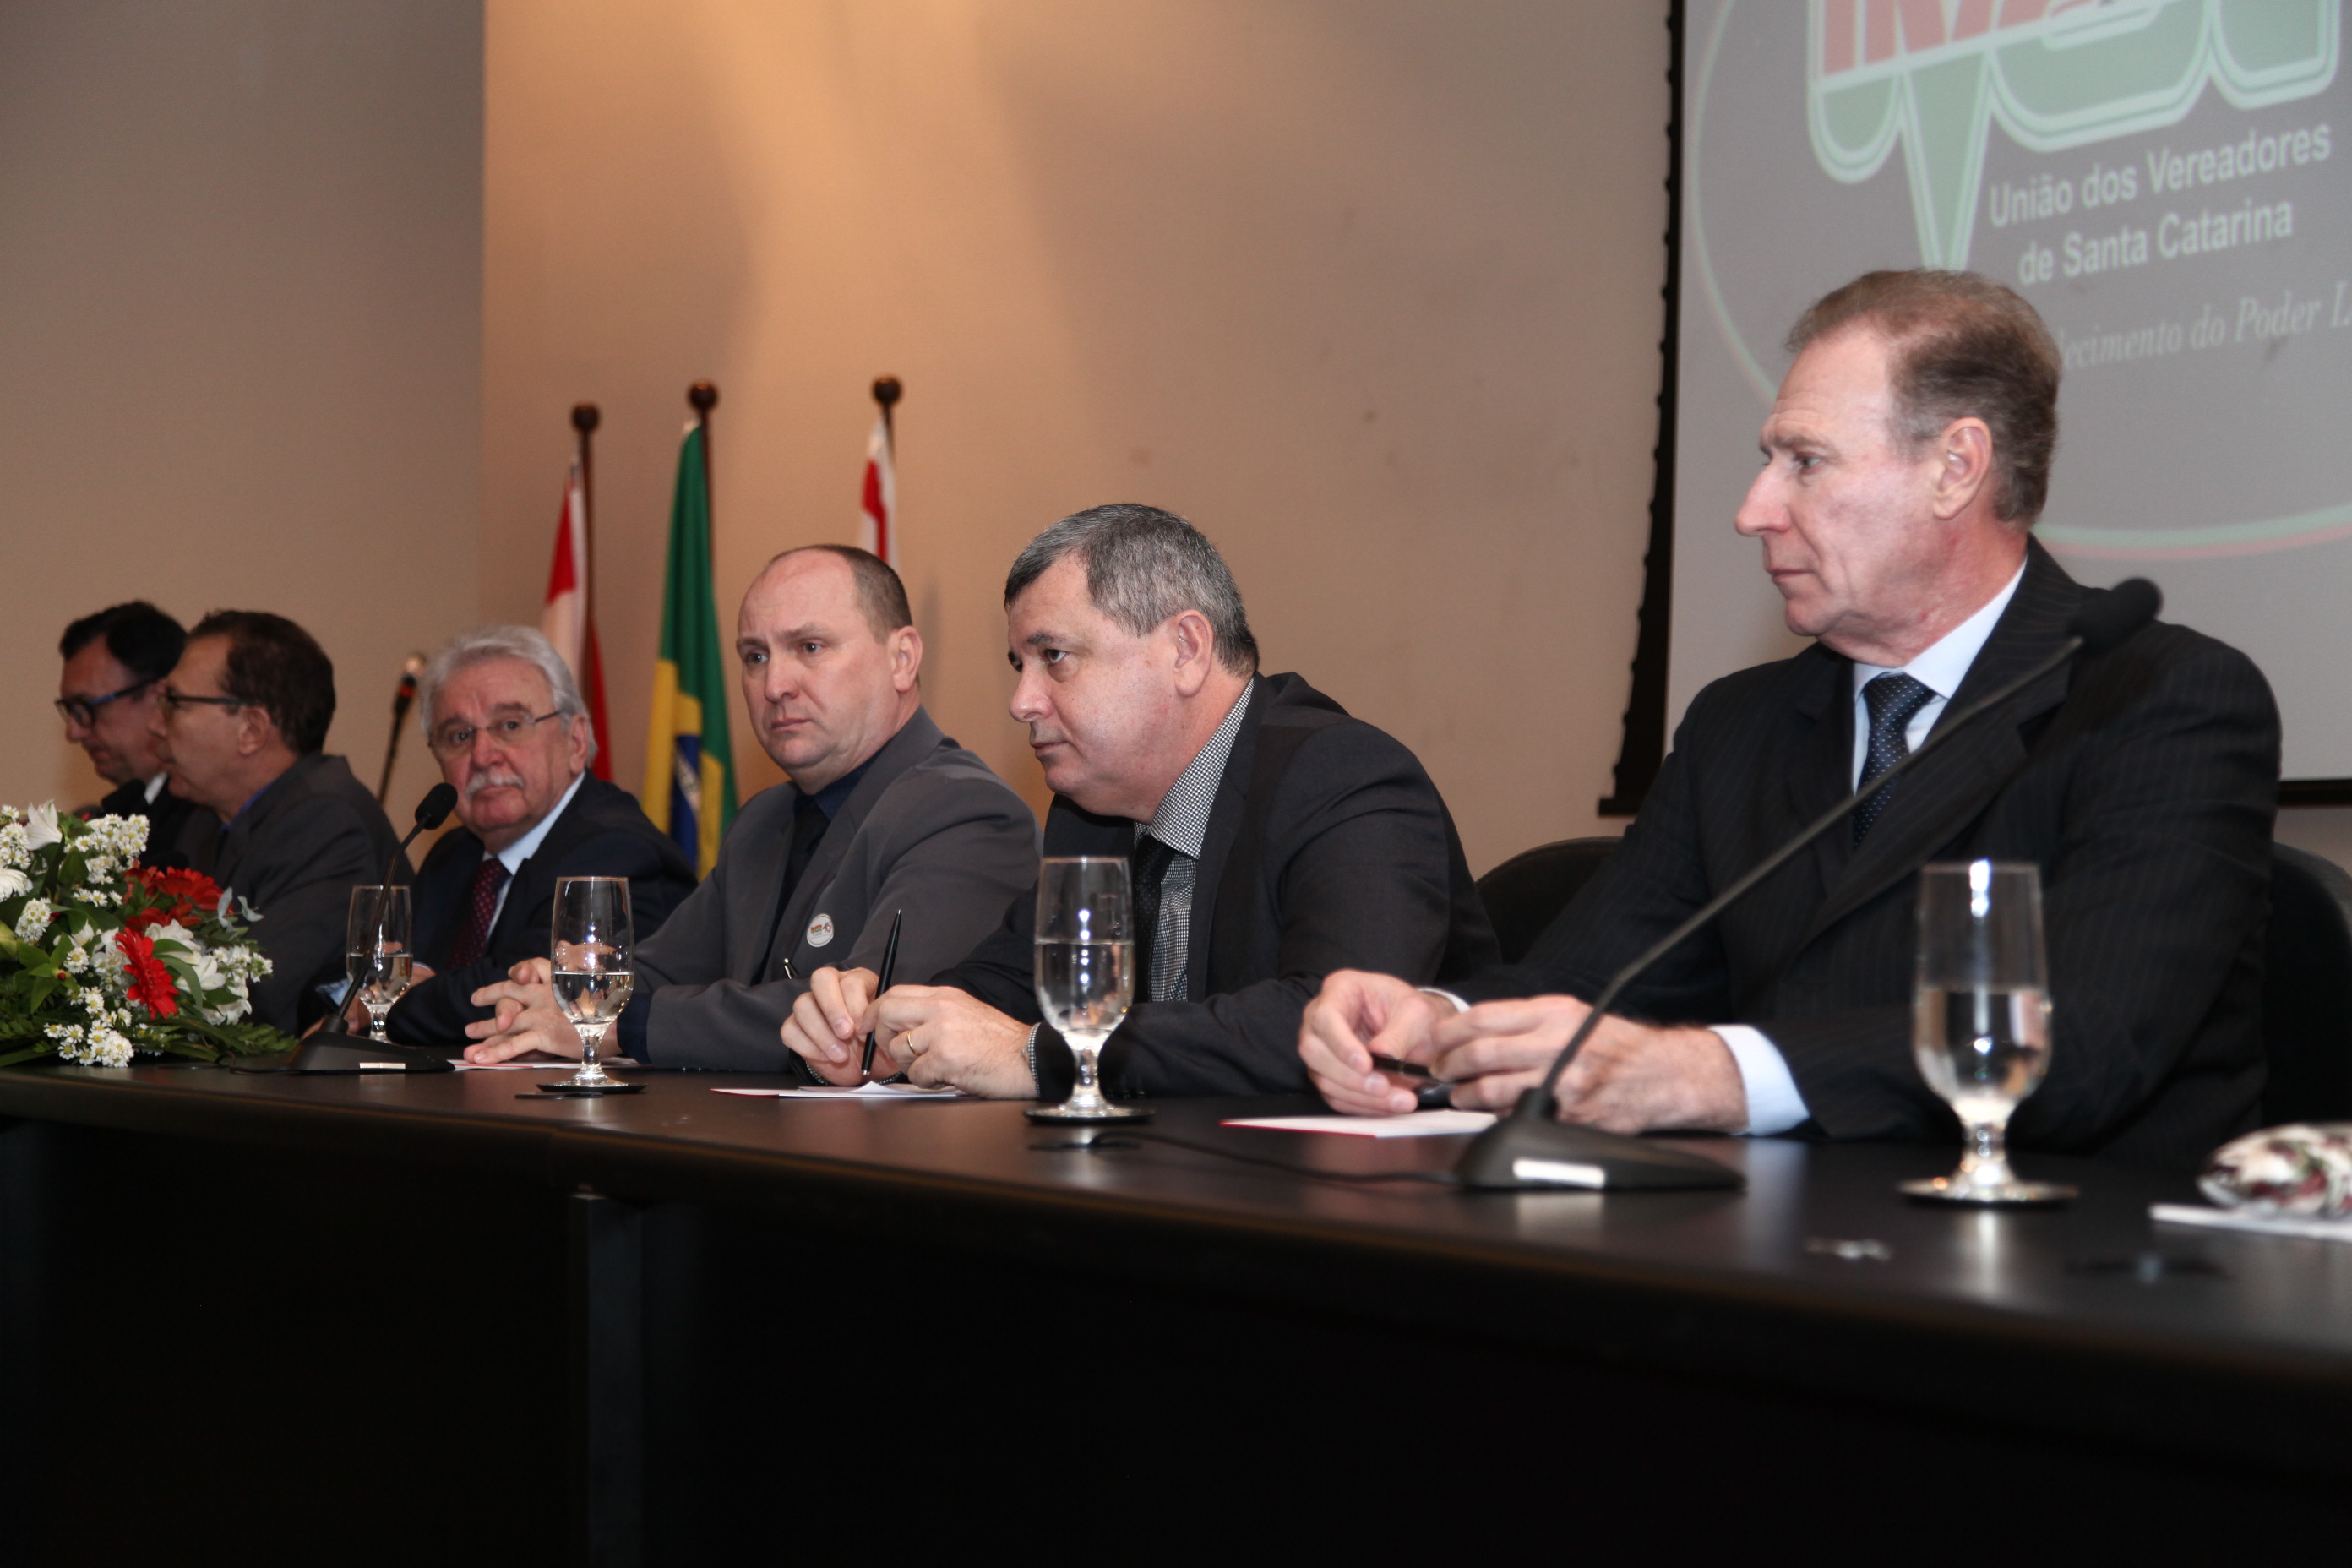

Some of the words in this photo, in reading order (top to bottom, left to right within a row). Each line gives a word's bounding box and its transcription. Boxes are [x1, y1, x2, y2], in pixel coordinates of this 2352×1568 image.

[1990, 174, 2074, 228] União
[2082, 164, 2137, 210] dos
[2147, 123, 2331, 194] Vereadores
[2018, 242, 2054, 286] de
[2063, 225, 2148, 278] Santa
[2159, 199, 2292, 259] Catarina
[2060, 319, 2183, 371] lecimento
[2191, 303, 2225, 349] do
[2235, 290, 2321, 341] Poder
